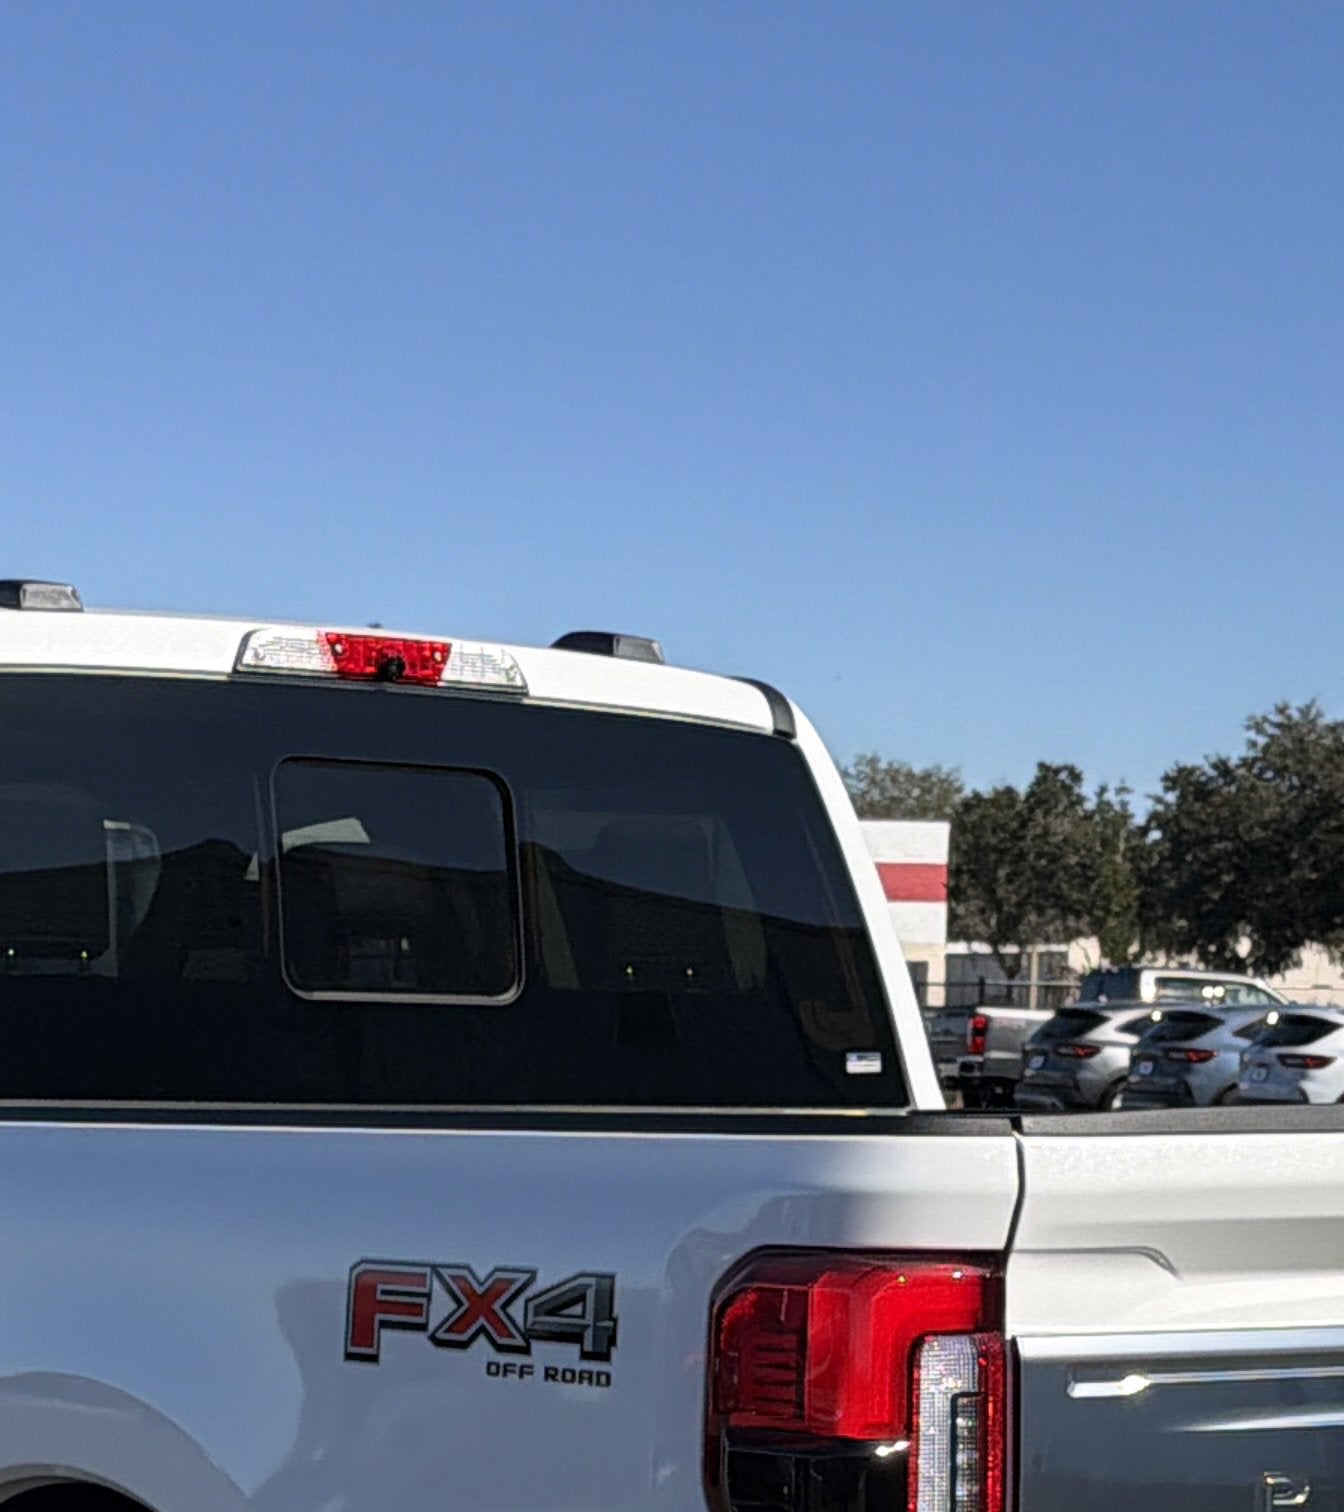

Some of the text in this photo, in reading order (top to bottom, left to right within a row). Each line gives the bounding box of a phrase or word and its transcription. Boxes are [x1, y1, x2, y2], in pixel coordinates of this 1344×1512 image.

[344, 1258, 617, 1364] FX4
[486, 1361, 612, 1388] OFF ROAD
